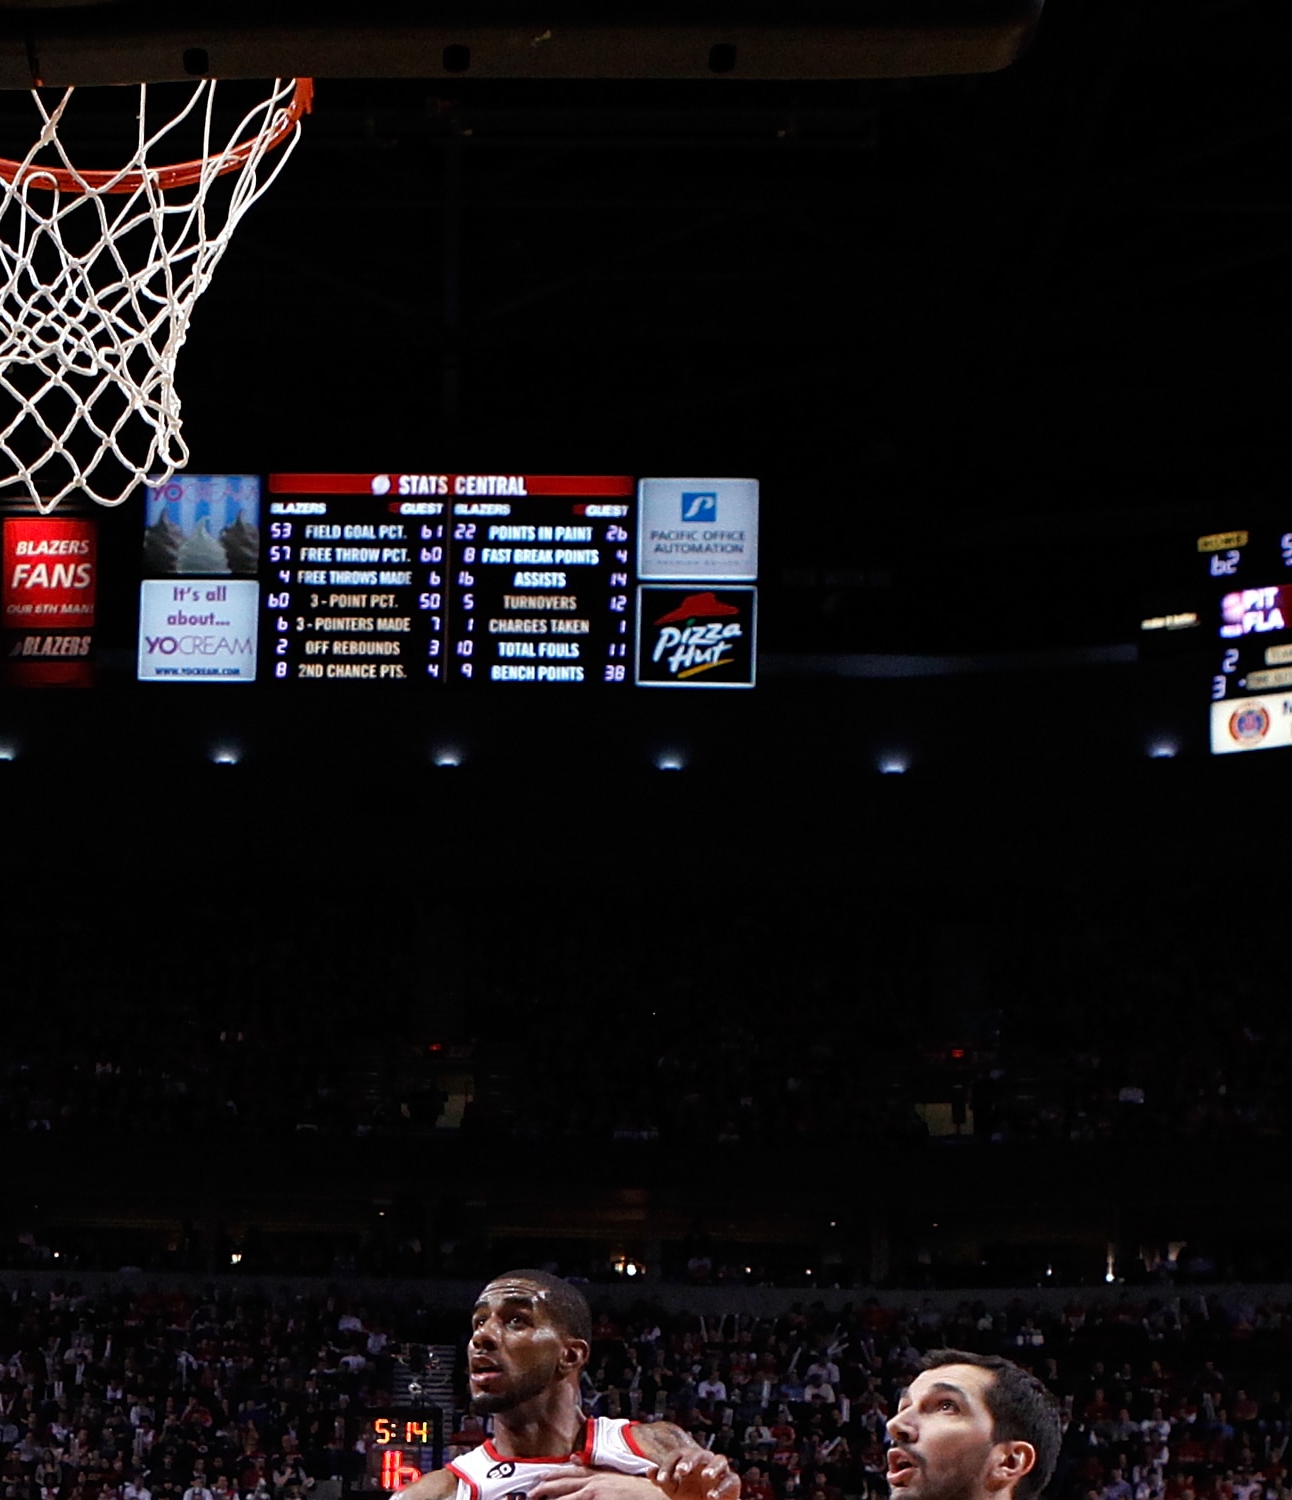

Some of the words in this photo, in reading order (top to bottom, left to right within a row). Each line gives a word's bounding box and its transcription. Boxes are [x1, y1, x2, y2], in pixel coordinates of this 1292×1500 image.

[399, 475, 449, 495] STATS
[455, 476, 527, 496] CENTRAL
[270, 502, 327, 515] BLAZERS
[400, 502, 444, 515] GUEST
[454, 504, 511, 516] BLAZERS
[585, 505, 629, 517] GUEST
[270, 523, 292, 539] 53
[305, 524, 341, 539] FIELD
[344, 525, 376, 539] GOAL
[379, 525, 407, 539] PCT.
[454, 524, 476, 540] 22
[488, 526, 535, 541] POINTS
[538, 526, 553, 541] IN
[555, 527, 593, 542] PAINT
[651, 530, 697, 541] PACIFIC
[703, 530, 745, 541] OFFICE
[16, 540, 90, 556] BLAZERS
[270, 546, 291, 562] 57
[300, 548, 332, 562] FREE
[335, 548, 380, 562] THROW
[382, 548, 411, 563] PCT.
[463, 547, 475, 563] 8
[482, 548, 511, 564] FAST
[513, 549, 553, 564] BREAK
[555, 550, 599, 565] POINTS
[616, 550, 627, 563] 4
[654, 543, 744, 553] AUTOMATION
[11, 563, 92, 589] FANS
[279, 570, 290, 583] 4
[297, 570, 327, 585] FREE
[330, 571, 378, 585] THROWS
[379, 571, 413, 585] MADE
[513, 572, 566, 587] ASSISTS
[610, 573, 627, 586] 14
[173, 586, 200, 601] It's
[206, 586, 226, 601] all
[310, 594, 319, 608] 3
[329, 594, 367, 608] POINT
[370, 595, 399, 608] PCT.
[420, 593, 441, 609] 50
[1242, 587, 1279, 610] PIT
[7, 604, 34, 614] OUR
[35, 604, 58, 614] 6TH
[463, 594, 474, 610] 5
[503, 595, 577, 610] TURNOVERS
[610, 595, 627, 611] 12
[167, 610, 230, 626] about...
[296, 617, 304, 631] 3
[315, 618, 374, 631] POINTERS
[377, 618, 411, 631] MADE
[431, 617, 440, 631] 7
[489, 619, 547, 633] CHARGES
[550, 620, 589, 633] TAKEN
[1242, 608, 1285, 634] FLA
[22, 636, 91, 656] BLAZERS
[145, 635, 253, 655] YOCREAM
[276, 639, 288, 655] 2
[305, 641, 329, 655] OFF
[333, 641, 400, 655] REBOUNDS
[429, 640, 440, 656] 3
[653, 618, 743, 662] Pizza
[457, 640, 473, 656] 10
[498, 642, 536, 657] TOTAL
[538, 643, 579, 658] FOULS
[667, 641, 733, 673] Hut
[1222, 649, 1239, 673] 2
[275, 662, 287, 678] 8
[298, 664, 323, 678] 2ND
[326, 665, 376, 678] CHANCE
[379, 665, 407, 678] PTS.
[428, 664, 439, 677] 4
[461, 663, 472, 678] 9
[490, 666, 535, 681] BENCH
[538, 666, 584, 681] POINTS
[1212, 675, 1226, 700] 3
[375, 1419, 427, 1444] 5:14
[489, 1463, 512, 1478] 20
